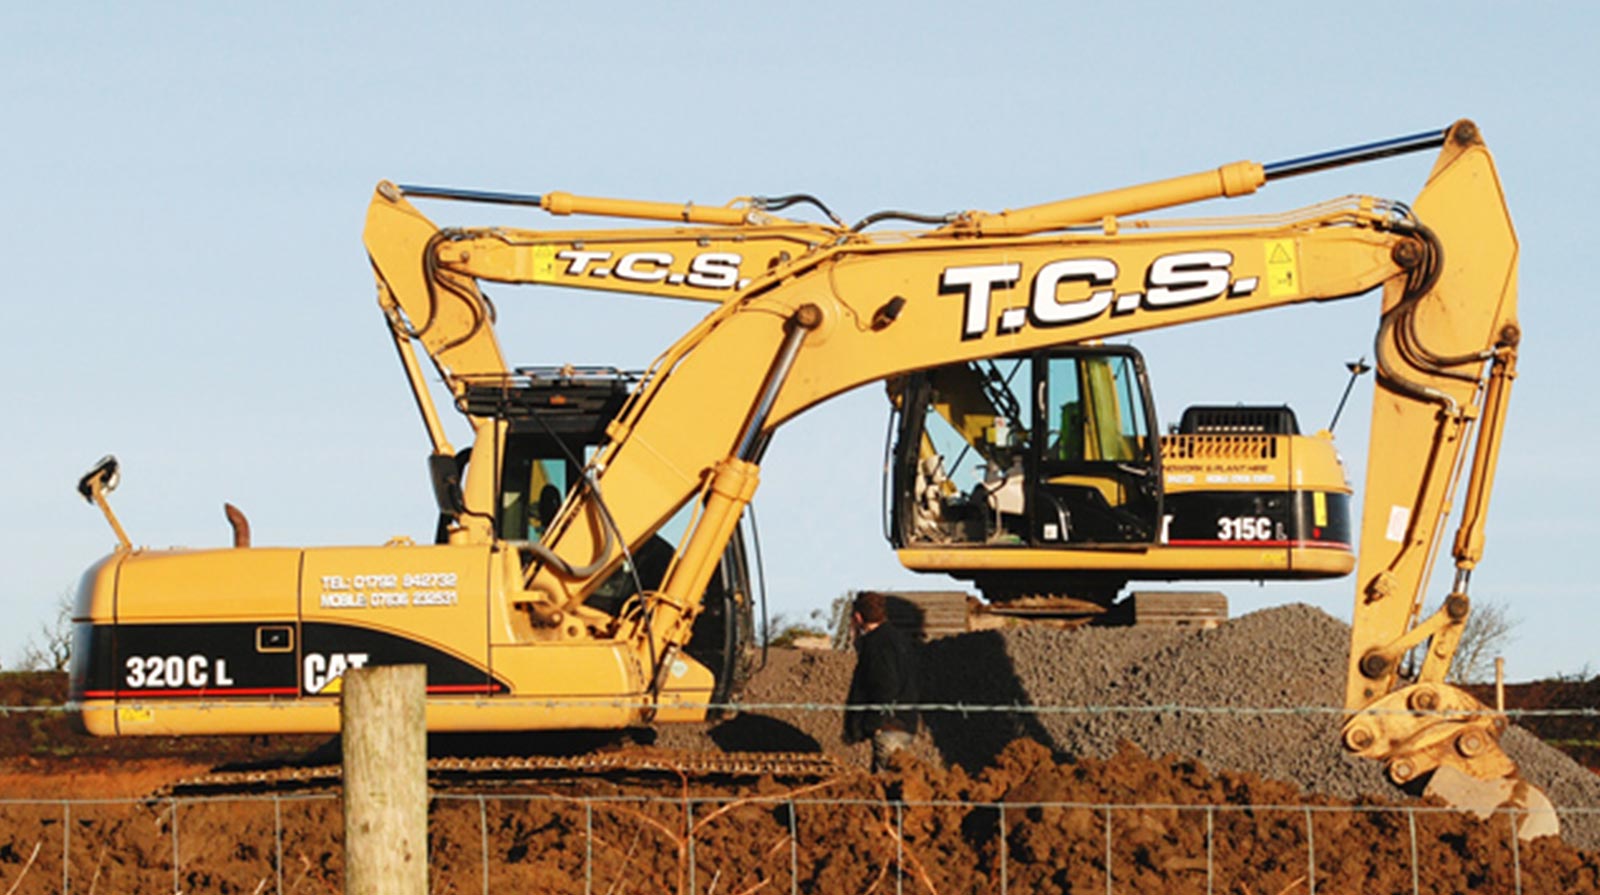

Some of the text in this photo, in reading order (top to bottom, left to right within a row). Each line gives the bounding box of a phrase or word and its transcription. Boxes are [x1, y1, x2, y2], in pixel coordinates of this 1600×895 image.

[555, 250, 750, 291] T.C.S.
[938, 250, 1259, 342] T.C.S.
[1217, 517, 1272, 540] 315C
[126, 654, 234, 688] 320C L
